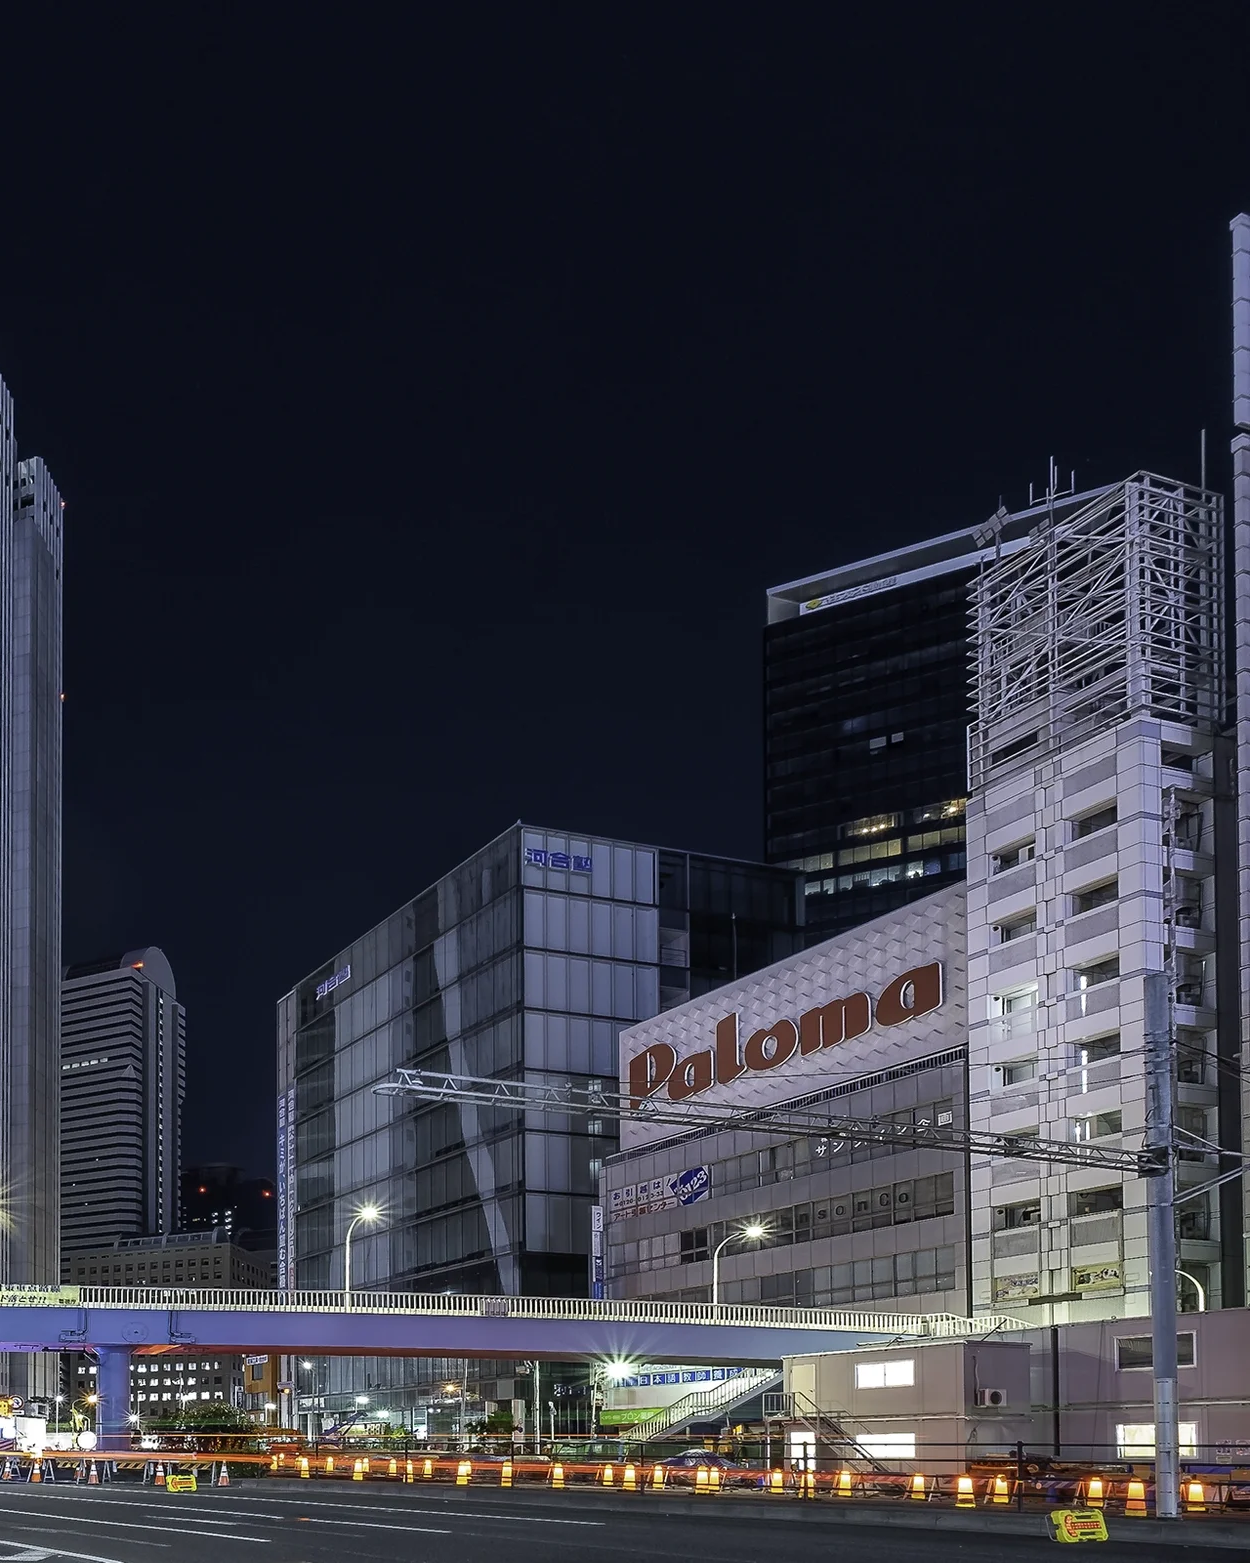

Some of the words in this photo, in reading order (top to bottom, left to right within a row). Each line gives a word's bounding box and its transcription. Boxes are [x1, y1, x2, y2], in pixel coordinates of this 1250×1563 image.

[525, 848, 592, 872] 河合塾
[629, 962, 943, 1110] Paloma
[680, 1170, 707, 1200] 0123
